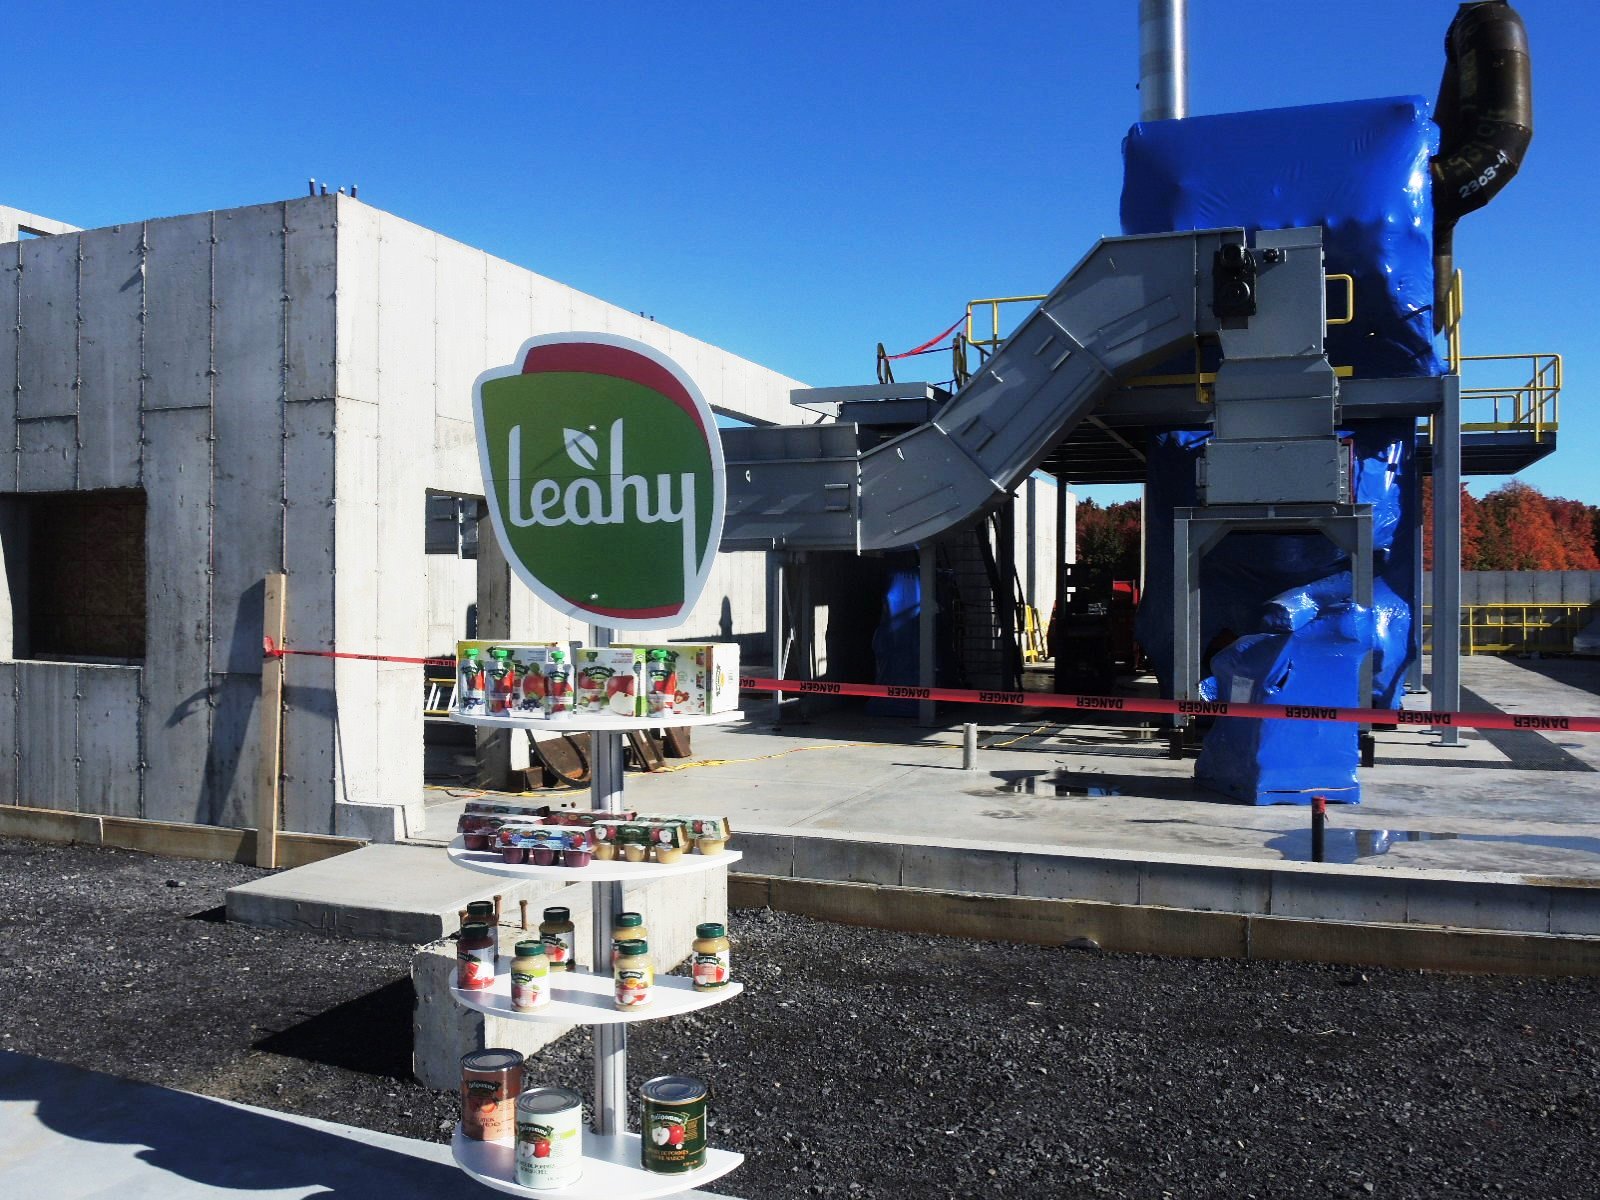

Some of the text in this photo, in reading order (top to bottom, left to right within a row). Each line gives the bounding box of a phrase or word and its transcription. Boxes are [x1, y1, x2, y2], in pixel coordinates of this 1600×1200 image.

[1458, 149, 1508, 198] 2303-4
[508, 418, 696, 602] leahy
[799, 682, 841, 693] DANGER
[887, 687, 930, 698] DANGER
[979, 691, 1024, 704] DANGER
[1076, 696, 1123, 709] DANGER
[1179, 701, 1228, 714] DANGER
[1285, 707, 1337, 719] DANGER
[1397, 712, 1451, 724] DANGER
[1514, 716, 1569, 729] DANGER
